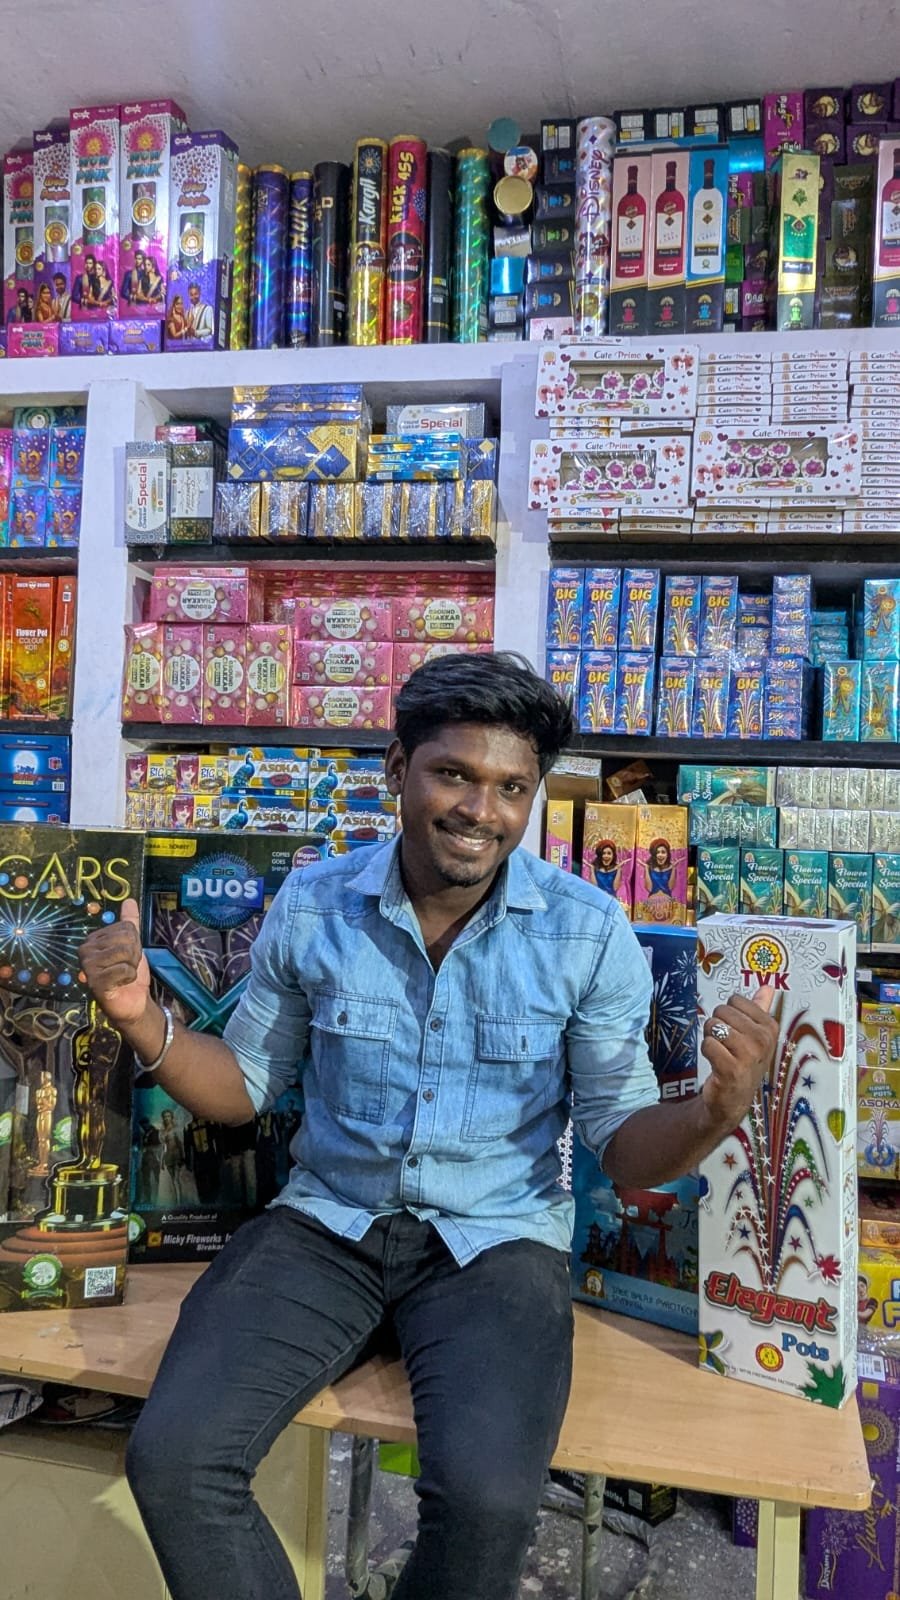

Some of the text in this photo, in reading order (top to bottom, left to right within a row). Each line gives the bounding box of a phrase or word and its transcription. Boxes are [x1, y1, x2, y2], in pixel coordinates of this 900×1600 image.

[358, 177, 380, 225] Kargil
[594, 350, 642, 359] Cute Prime
[420, 417, 463, 430] Special
[773, 429, 802, 437] Prime
[585, 442, 632, 450] Cute Prime
[138, 463, 149, 506] Special
[555, 589, 577, 600] BIG
[590, 590, 613, 601] BIG
[630, 589, 652, 601] BIG
[670, 595, 693, 607] BIG
[708, 595, 730, 607] BIG
[16, 629, 48, 637] Flower Pot
[552, 671, 574, 683] BIG
[588, 671, 611, 683] BIG
[624, 673, 646, 685] BIG
[665, 678, 687, 689] BIG
[701, 678, 723, 689] BIG
[737, 678, 760, 689] BIG
[702, 771, 712, 800] Special
[212, 868, 235, 876] BIG
[704, 872, 734, 881] Special
[747, 873, 777, 882] Special
[791, 874, 822, 885] Special
[836, 878, 867, 889] Special
[187, 878, 259, 899] DUOS
[741, 969, 789, 991] TVK
[865, 1015, 897, 1023] ASOKA
[879, 1027, 888, 1066] ASOKA
[859, 1099, 899, 1108] ASOKA
[163, 1234, 185, 1246] Micky
[186, 1233, 222, 1244] Fireworks
[705, 1271, 838, 1333] Elegant
[781, 1333, 829, 1361] Pots
